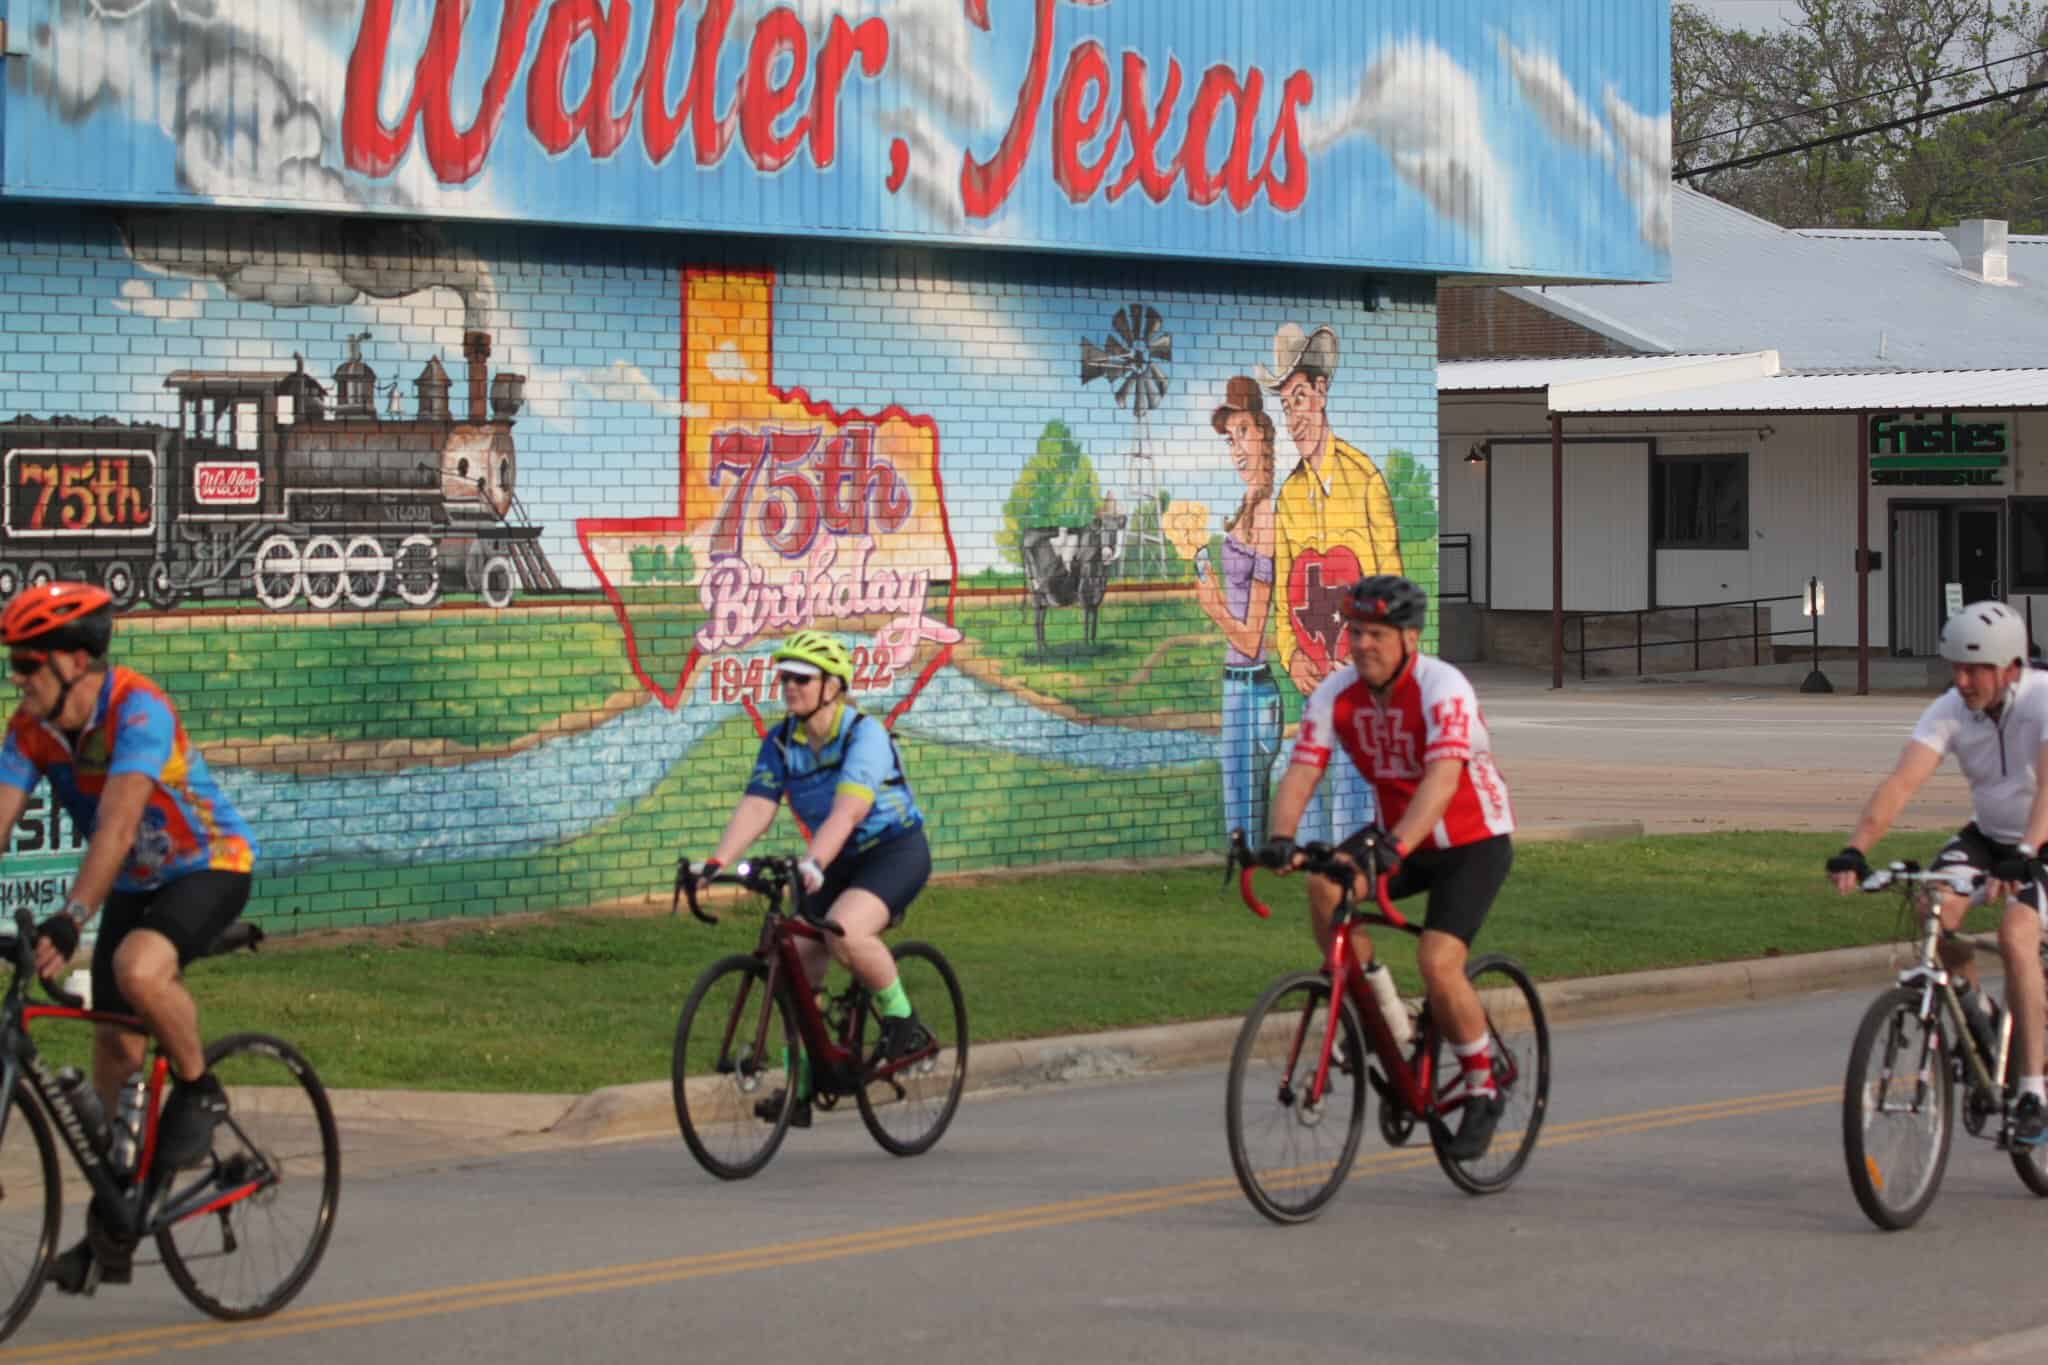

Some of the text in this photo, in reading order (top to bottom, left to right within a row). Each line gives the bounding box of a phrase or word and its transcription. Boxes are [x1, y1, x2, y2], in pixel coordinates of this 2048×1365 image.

[960, 0, 1314, 219] Texas
[20, 459, 150, 529] 75th
[200, 469, 264, 497] Waller
[708, 425, 912, 560] 75th
[696, 532, 964, 670] Birthday
[852, 645, 893, 691] 22
